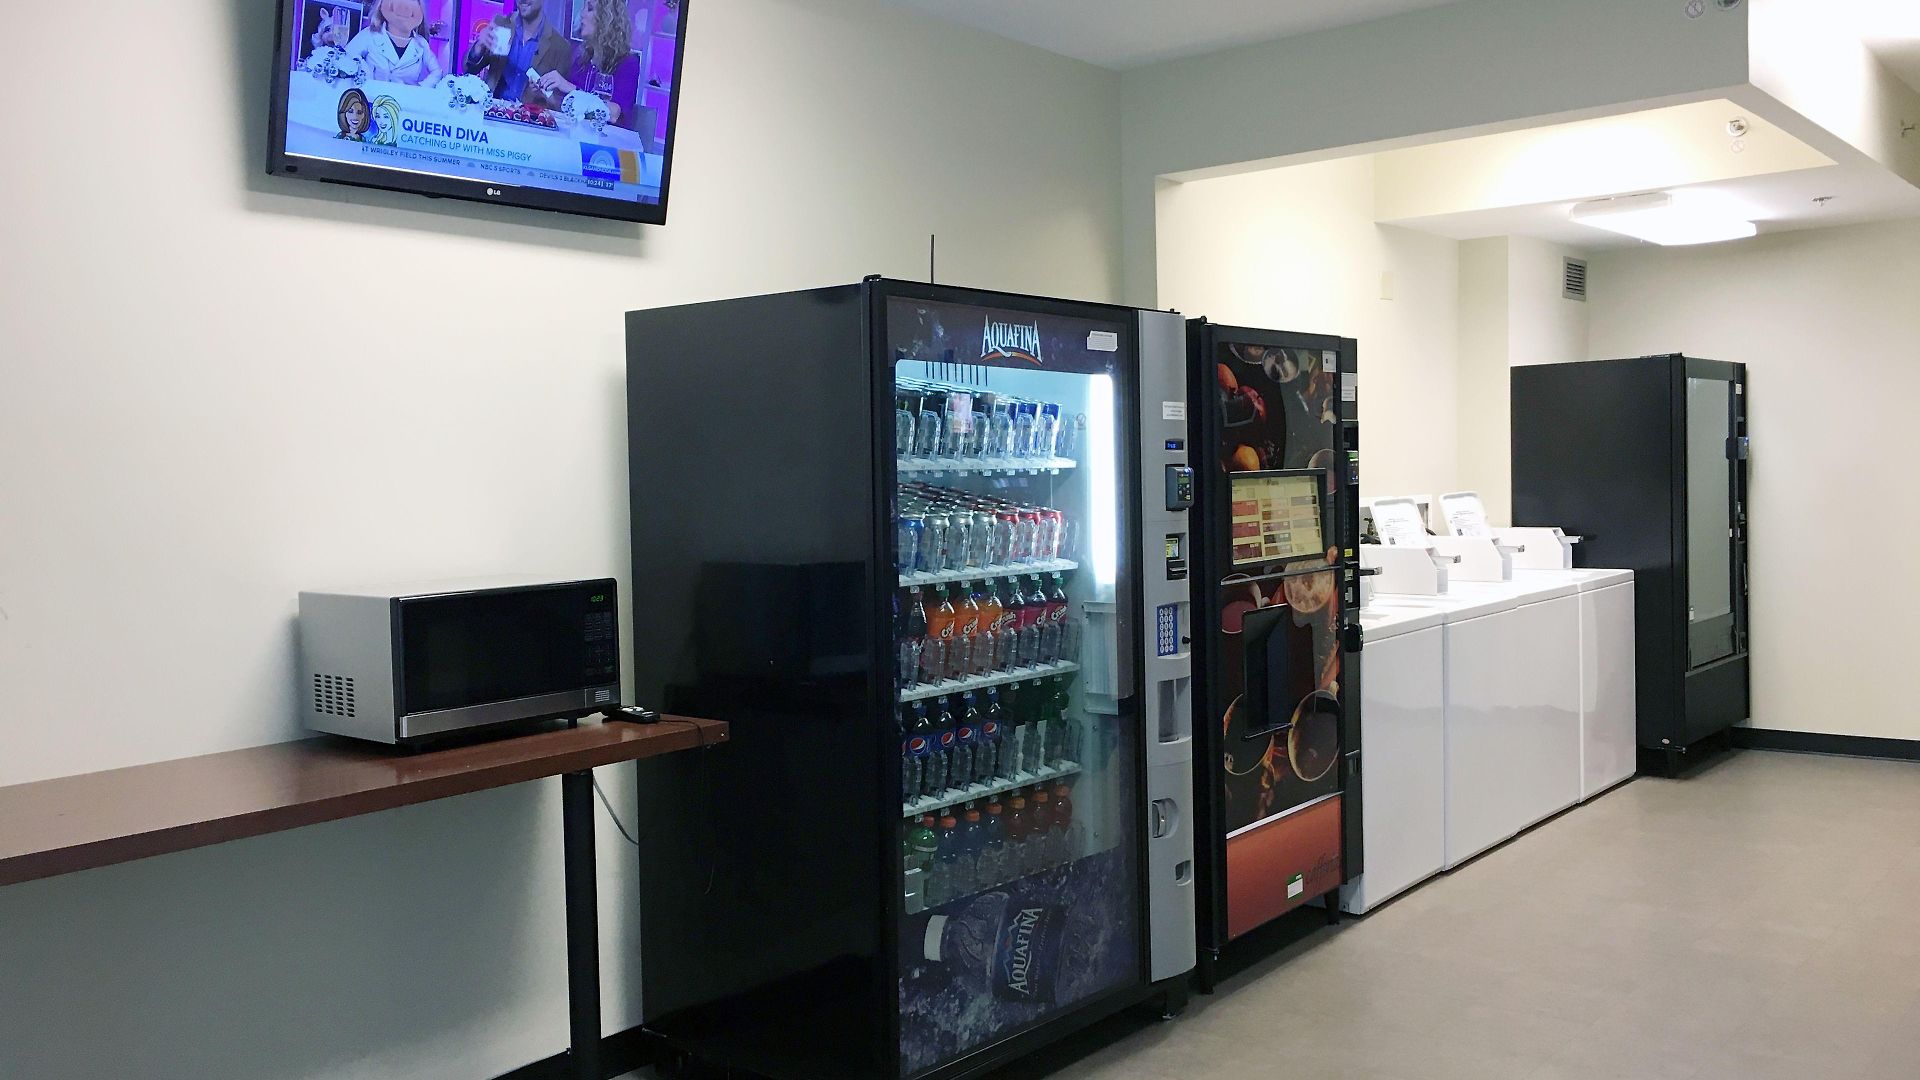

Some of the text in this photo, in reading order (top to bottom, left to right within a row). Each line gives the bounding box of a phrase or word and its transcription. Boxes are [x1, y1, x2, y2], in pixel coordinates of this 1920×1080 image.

[402, 118, 489, 144] QUEEN DIVA
[370, 147, 398, 156] WRIGLEY
[400, 151, 417, 160] FIELD
[434, 155, 461, 165] SUMMER
[401, 134, 532, 162] CATCHING UP WITH MISS PIGGY
[980, 314, 1043, 363] AQUAFINA
[1008, 908, 1043, 995] AQUAFINA
